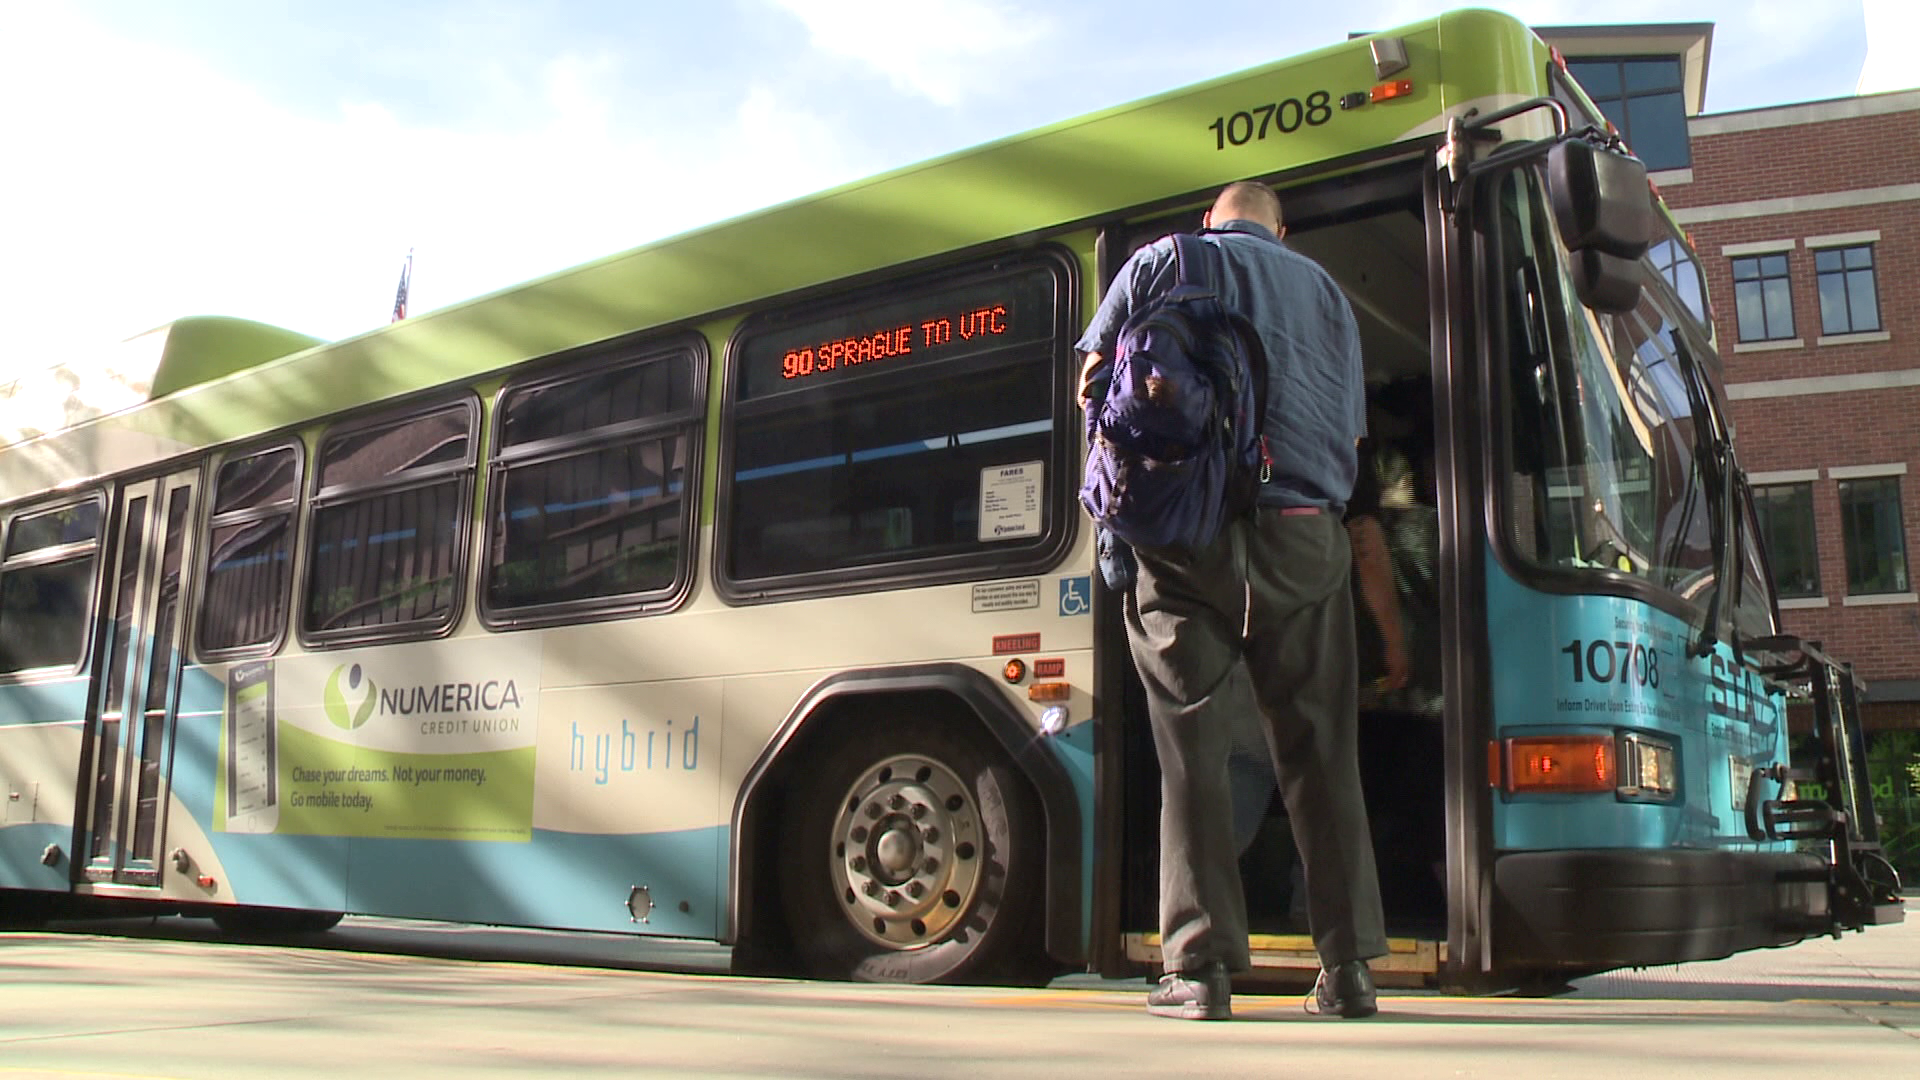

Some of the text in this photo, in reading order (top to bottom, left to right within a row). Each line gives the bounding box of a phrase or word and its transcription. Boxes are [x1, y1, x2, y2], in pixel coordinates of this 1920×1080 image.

[1208, 90, 1332, 150] 10708
[782, 349, 814, 379] 90
[817, 325, 912, 372] SPRAGUE
[1000, 468, 1024, 477] FARES
[996, 635, 1039, 651] KNEELING
[1037, 662, 1062, 675] RAMP
[1562, 640, 1659, 689] 10708
[380, 680, 520, 716] NUMERICA
[1557, 699, 1582, 712] Inform
[1585, 699, 1606, 712] Driver
[420, 719, 519, 735] CREDIT UNION
[571, 716, 699, 785] hybrid
[292, 766, 487, 786] Chase your dreams. Not your money.
[290, 791, 374, 812] Go mobile today.
